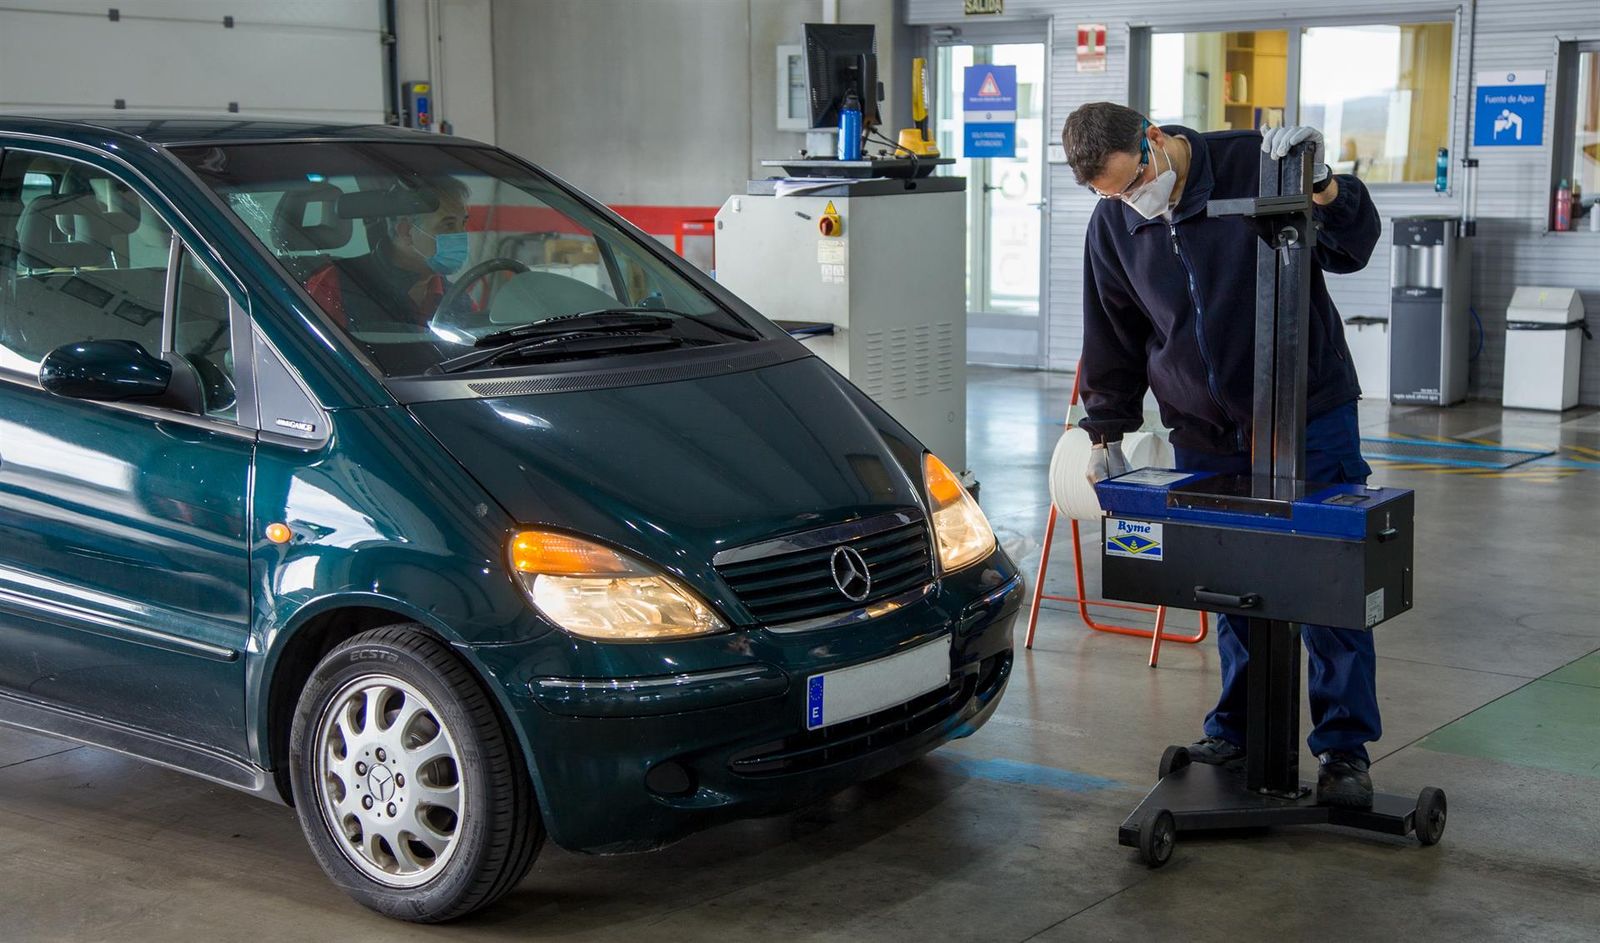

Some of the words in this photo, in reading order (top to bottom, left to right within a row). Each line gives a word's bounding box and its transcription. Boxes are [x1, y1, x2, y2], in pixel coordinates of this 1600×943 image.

[1485, 95, 1507, 104] Fuente
[1508, 95, 1516, 103] de
[1517, 94, 1535, 104] Agua
[1117, 520, 1151, 533] Ryme
[812, 706, 819, 718] E
